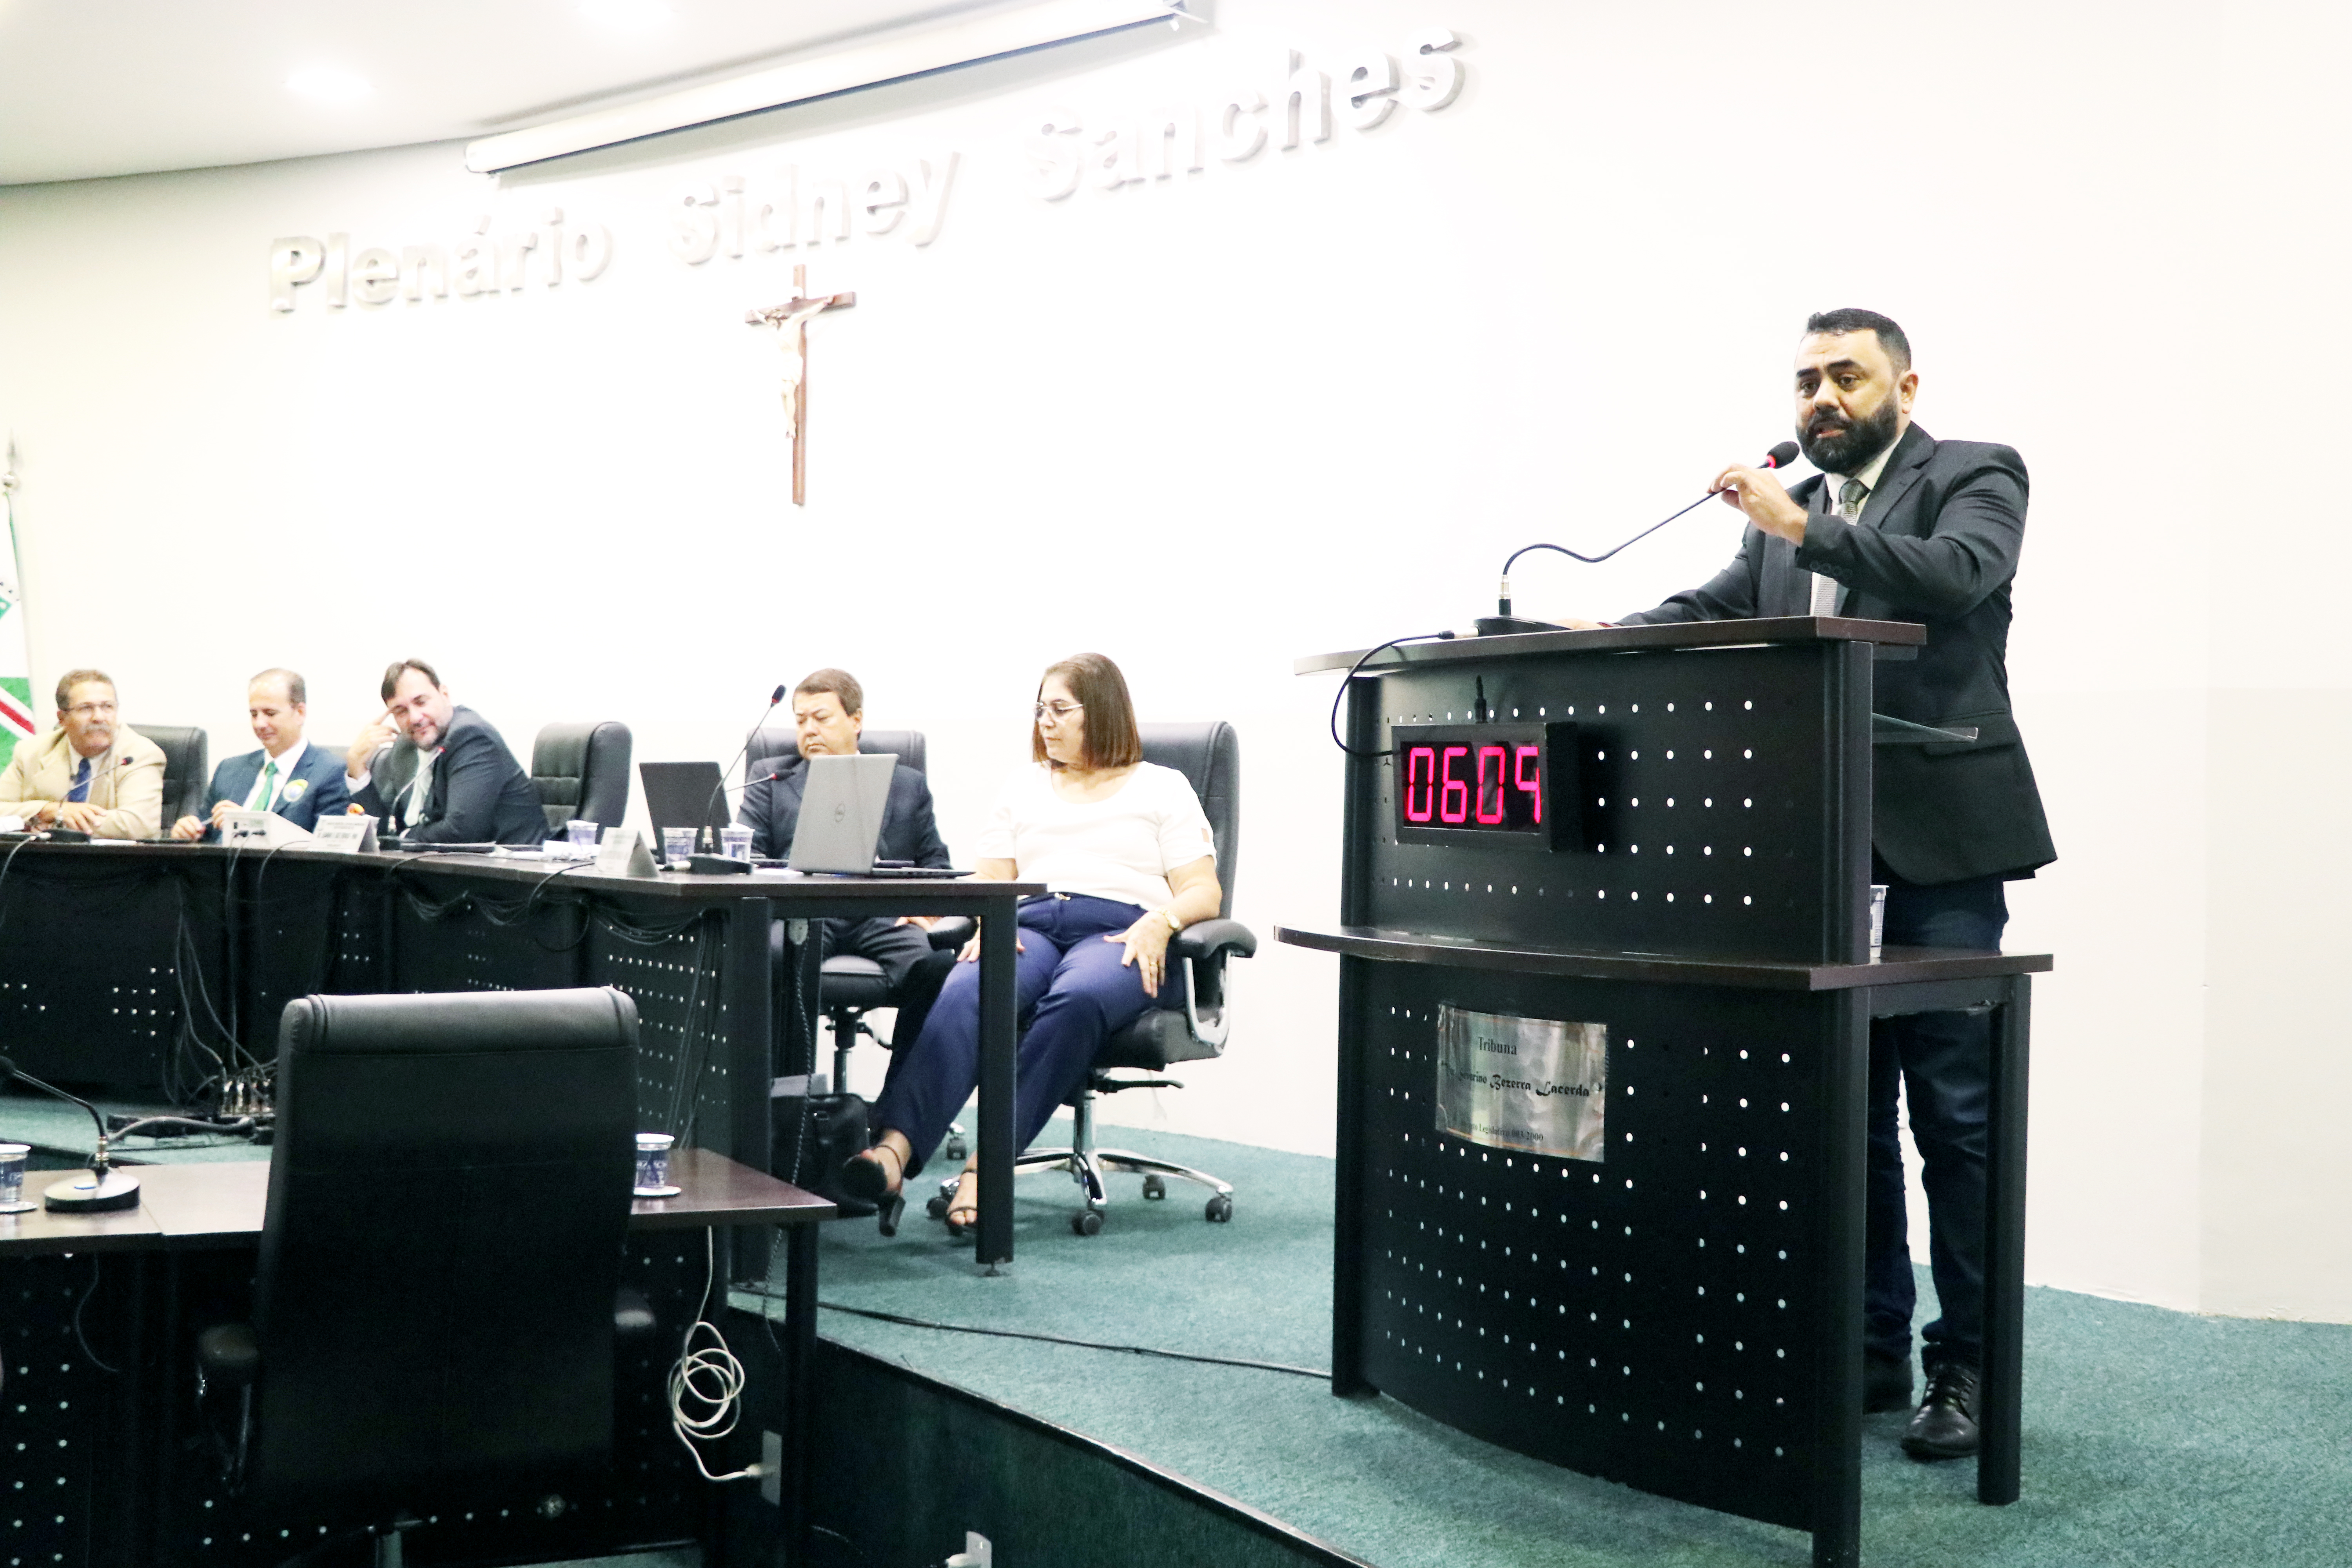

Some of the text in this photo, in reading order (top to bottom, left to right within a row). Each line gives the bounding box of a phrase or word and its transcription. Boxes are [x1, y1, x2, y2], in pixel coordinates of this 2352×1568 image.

[270, 27, 1468, 314] Plenário Sidney Sanches
[1477, 1036, 1517, 1055] Tribuna
[1490, 1074, 1531, 1090] Bezerra
[1535, 1081, 1590, 1097] Lacerda
